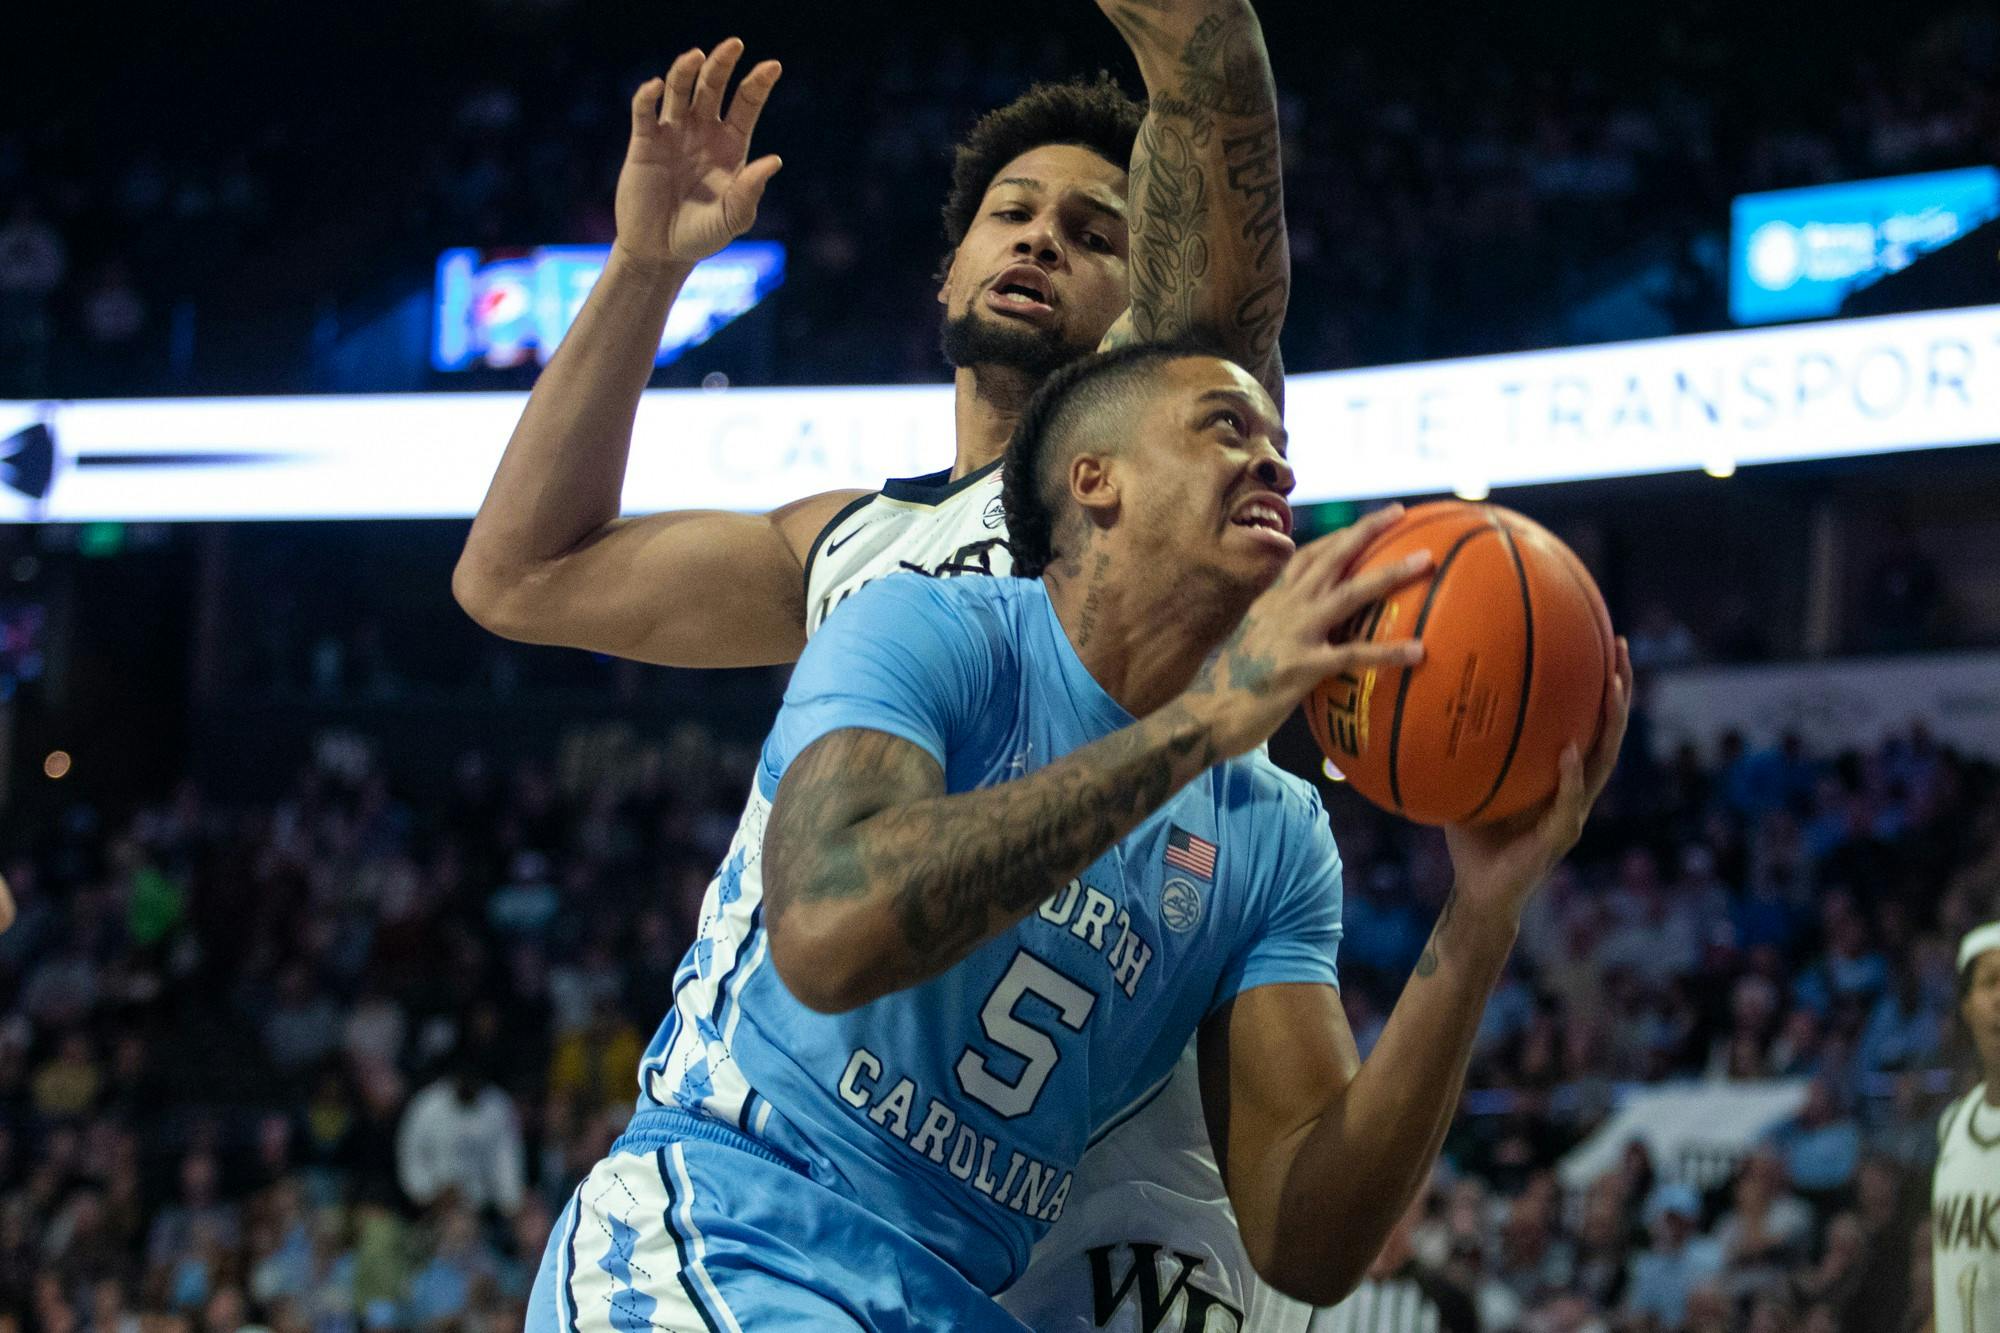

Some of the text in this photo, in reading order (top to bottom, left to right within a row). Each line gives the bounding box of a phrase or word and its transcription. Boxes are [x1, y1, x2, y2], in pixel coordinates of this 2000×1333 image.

[1497, 329, 2000, 446] TRANSPOR
[1038, 877, 1153, 1000] ORTH
[955, 946, 1099, 1120] 5
[838, 1046, 1074, 1223] CAROLINA
